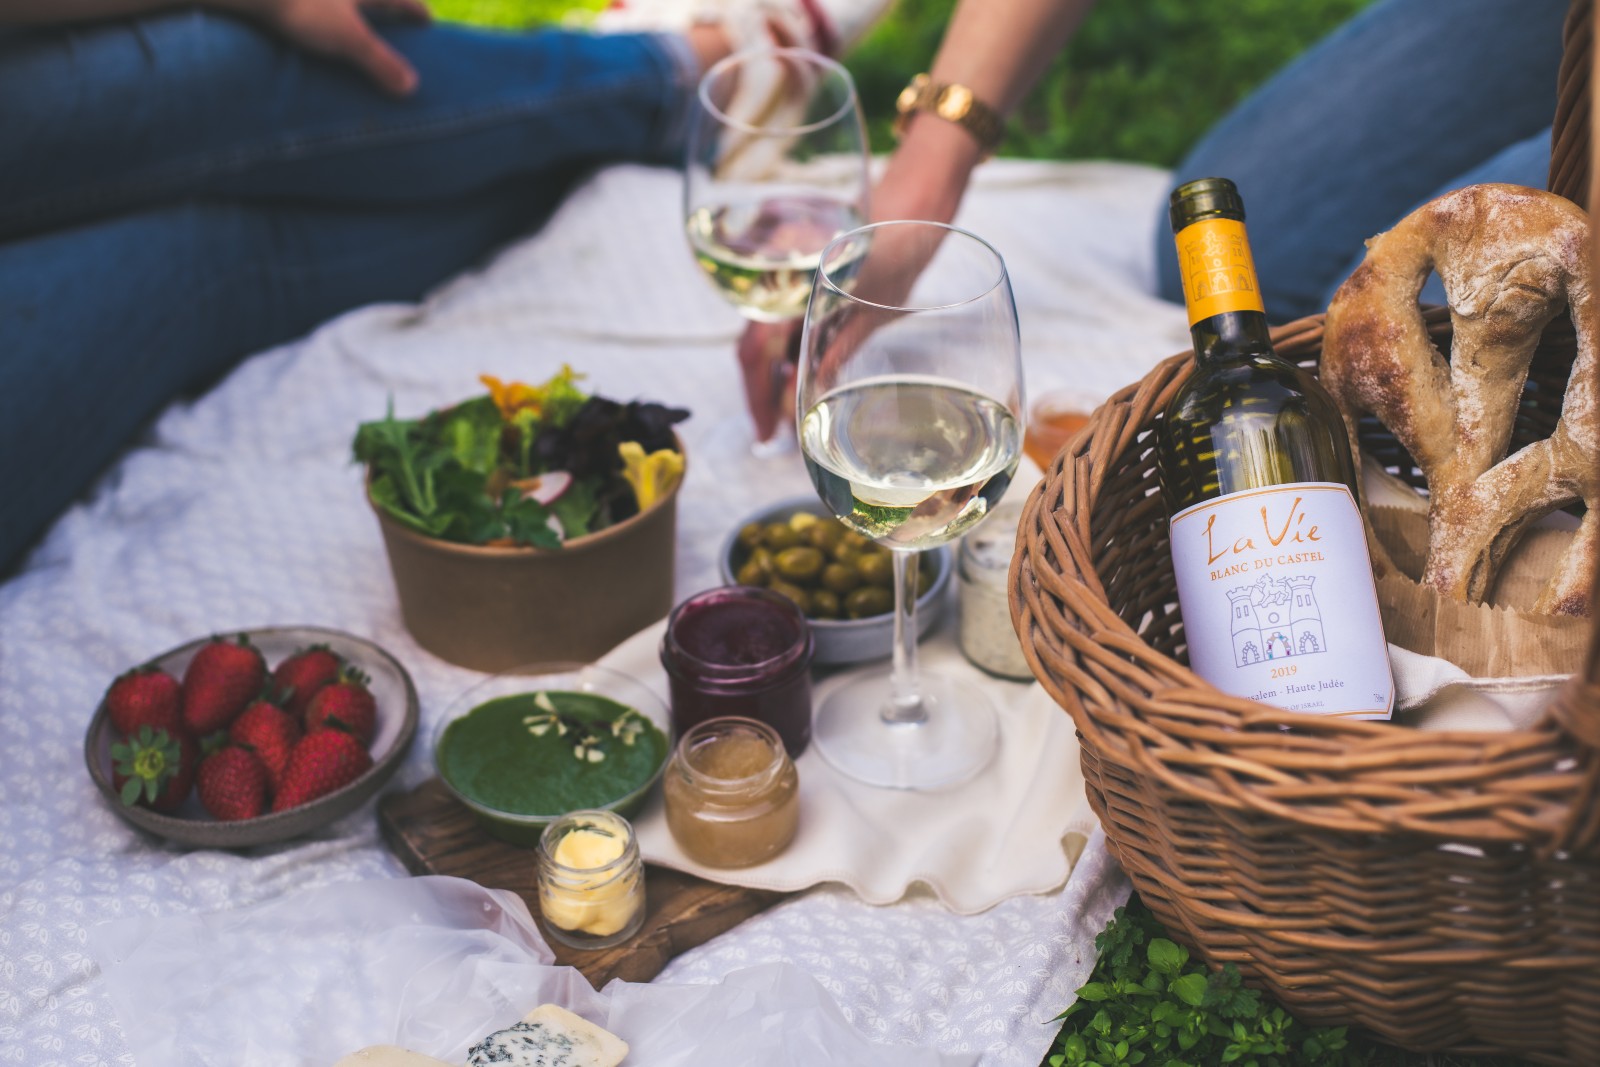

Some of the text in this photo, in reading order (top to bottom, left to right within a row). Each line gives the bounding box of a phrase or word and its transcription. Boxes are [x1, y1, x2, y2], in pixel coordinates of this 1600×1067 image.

[1201, 497, 1322, 566] La Vie
[1210, 551, 1325, 581] BLANC DU CASTEL
[1271, 665, 1298, 679] 2019
[1285, 684, 1316, 695] Haute
[1317, 679, 1345, 692] Judée
[1301, 700, 1325, 710] ISRAEL
